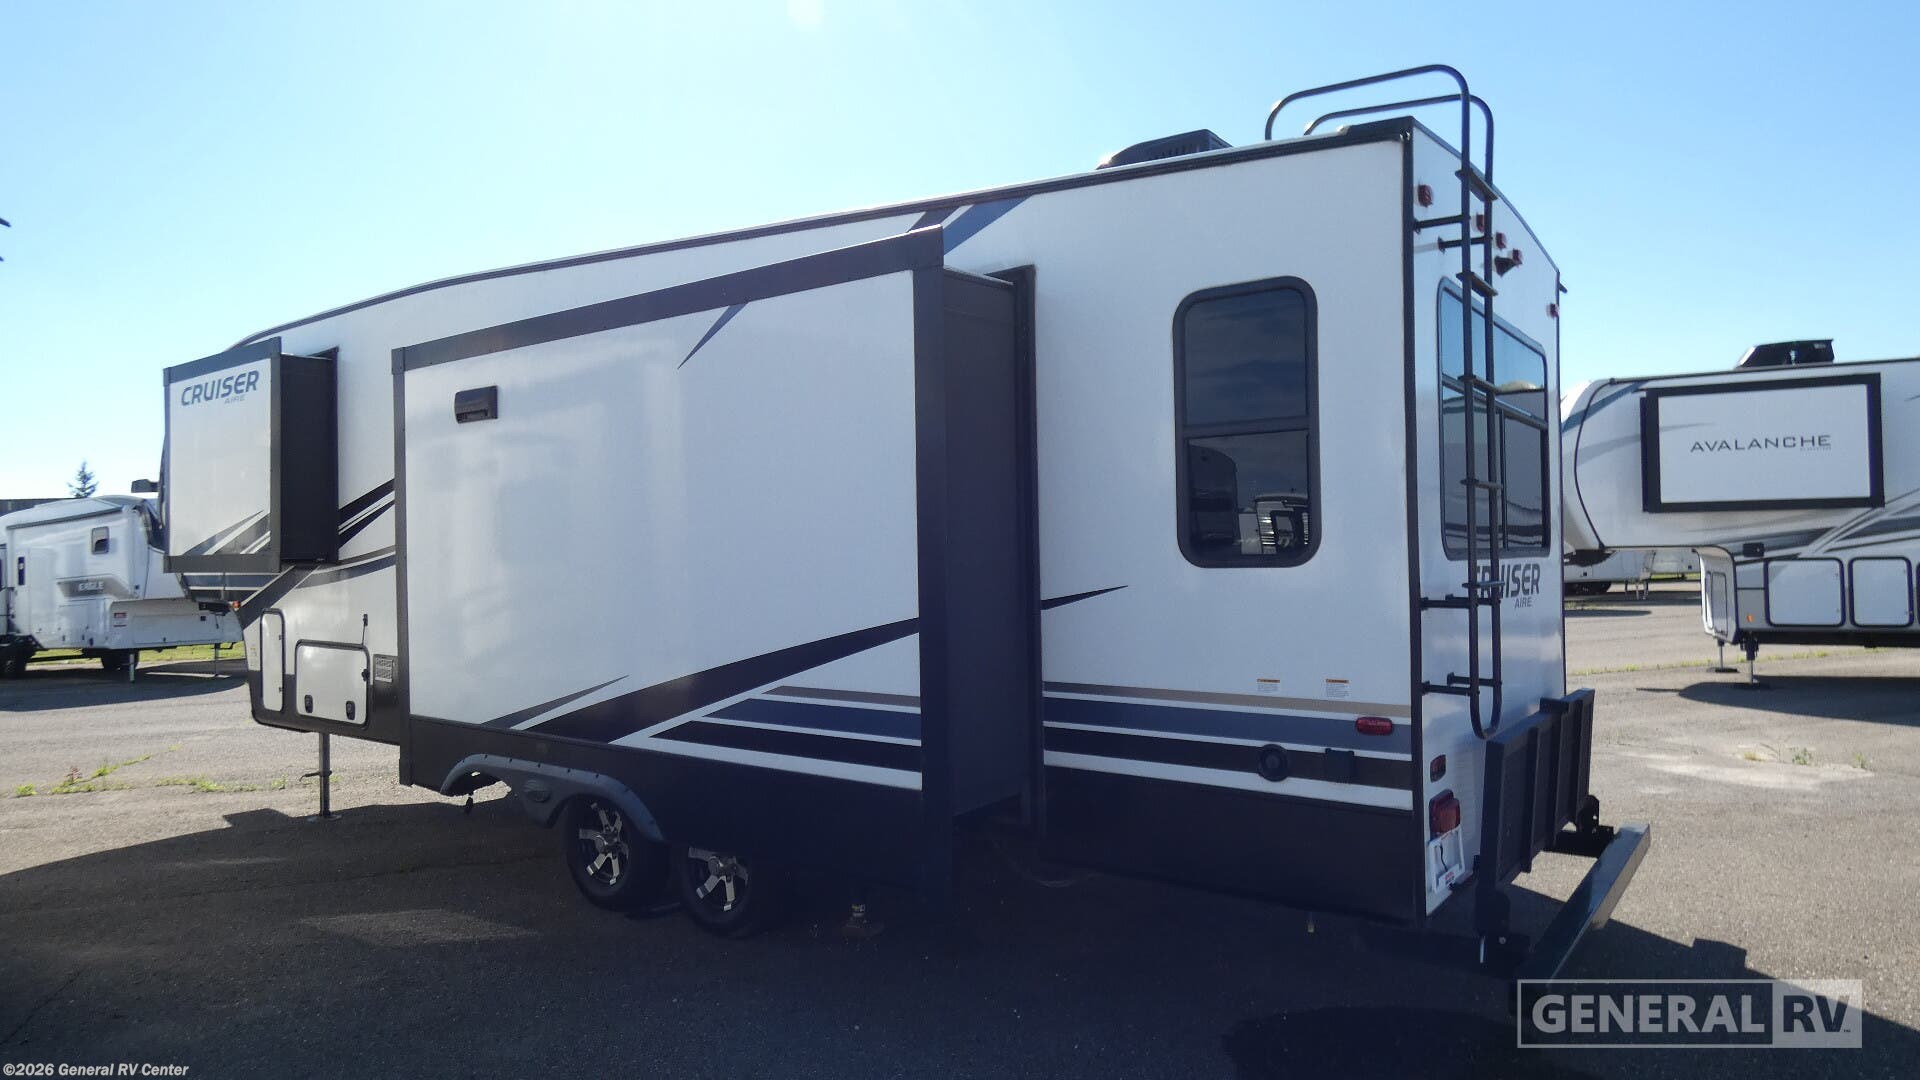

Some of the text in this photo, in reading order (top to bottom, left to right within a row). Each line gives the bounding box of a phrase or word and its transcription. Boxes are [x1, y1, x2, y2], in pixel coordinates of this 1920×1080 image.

[181, 370, 260, 406] CRUISER
[1690, 434, 1832, 453] AVALANCHE
[1514, 597, 1533, 609] AIRE
